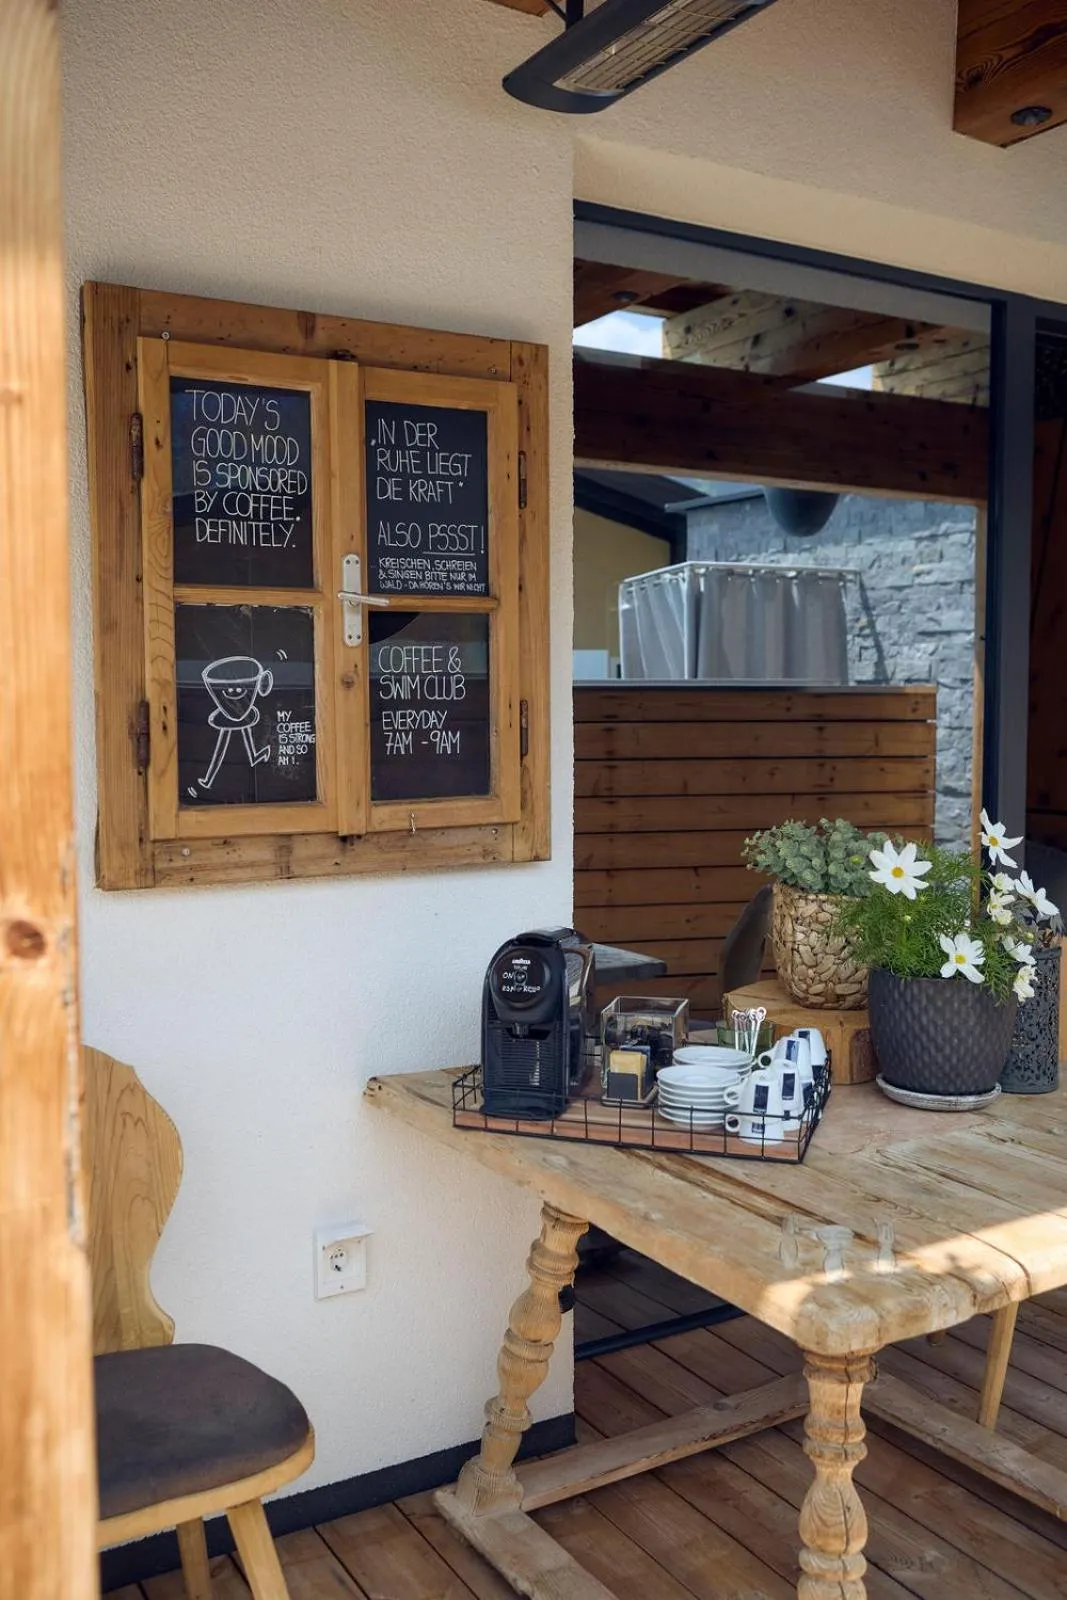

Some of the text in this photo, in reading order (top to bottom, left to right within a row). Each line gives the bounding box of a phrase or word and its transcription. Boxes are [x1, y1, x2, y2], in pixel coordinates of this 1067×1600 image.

[184, 389, 281, 431] TODAY'S
[191, 426, 300, 466] GOOD MOOD
[404, 421, 439, 449] DER
[377, 448, 472, 477] RUHE LIEGT
[193, 459, 308, 495] IS SPONSORED
[377, 477, 403, 501] DIE
[194, 490, 300, 521] BY COFFEE.
[195, 518, 296, 548] DEFINITELY.
[378, 521, 484, 554] ALSO PSSST!
[378, 569, 387, 579] &
[388, 570, 422, 579] SINGEN
[425, 571, 448, 581] BITTE
[450, 573, 467, 581] NUR
[434, 560, 477, 571] SCHREIEN
[380, 580, 402, 589] WALD
[467, 583, 485, 592] NICHT
[378, 646, 462, 673] COFFEE &
[379, 674, 466, 700] SWIM CLUB
[277, 711, 292, 721] MY
[277, 721, 311, 733] COFFEE
[382, 710, 447, 730] EVERYDAY
[279, 733, 315, 744] IS STRONG
[279, 744, 308, 754] AND SO
[384, 732, 412, 754] 7AM
[430, 730, 460, 754] 9AM
[278, 756, 289, 765] AM
